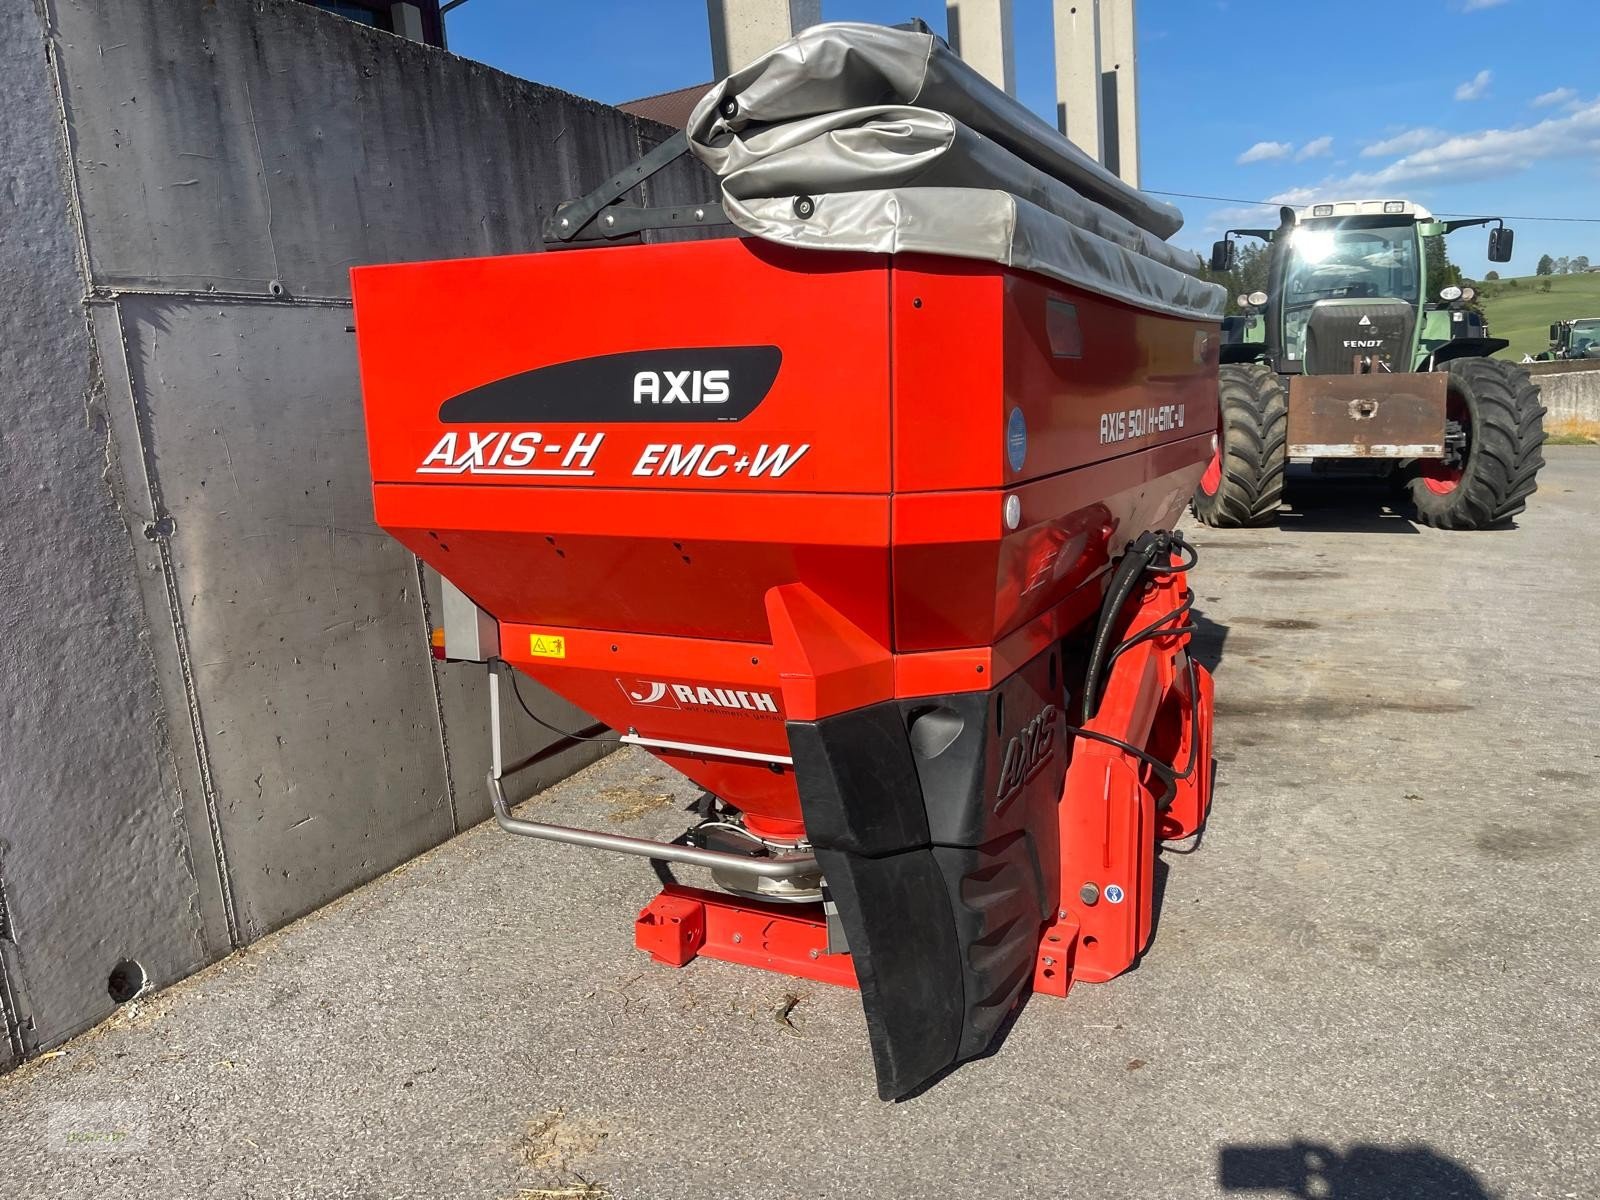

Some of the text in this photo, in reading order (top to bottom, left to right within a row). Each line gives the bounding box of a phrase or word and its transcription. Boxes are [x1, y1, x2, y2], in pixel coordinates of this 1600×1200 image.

[1343, 340, 1383, 348] FENDT
[633, 370, 730, 405] AXIS
[1100, 412, 1126, 445] AXIS
[1128, 409, 1146, 439] 50.1
[419, 431, 606, 472] AXIS-H
[632, 443, 810, 479] EMC+W
[671, 684, 778, 713] RAUCH
[996, 703, 1057, 800] AXIS
